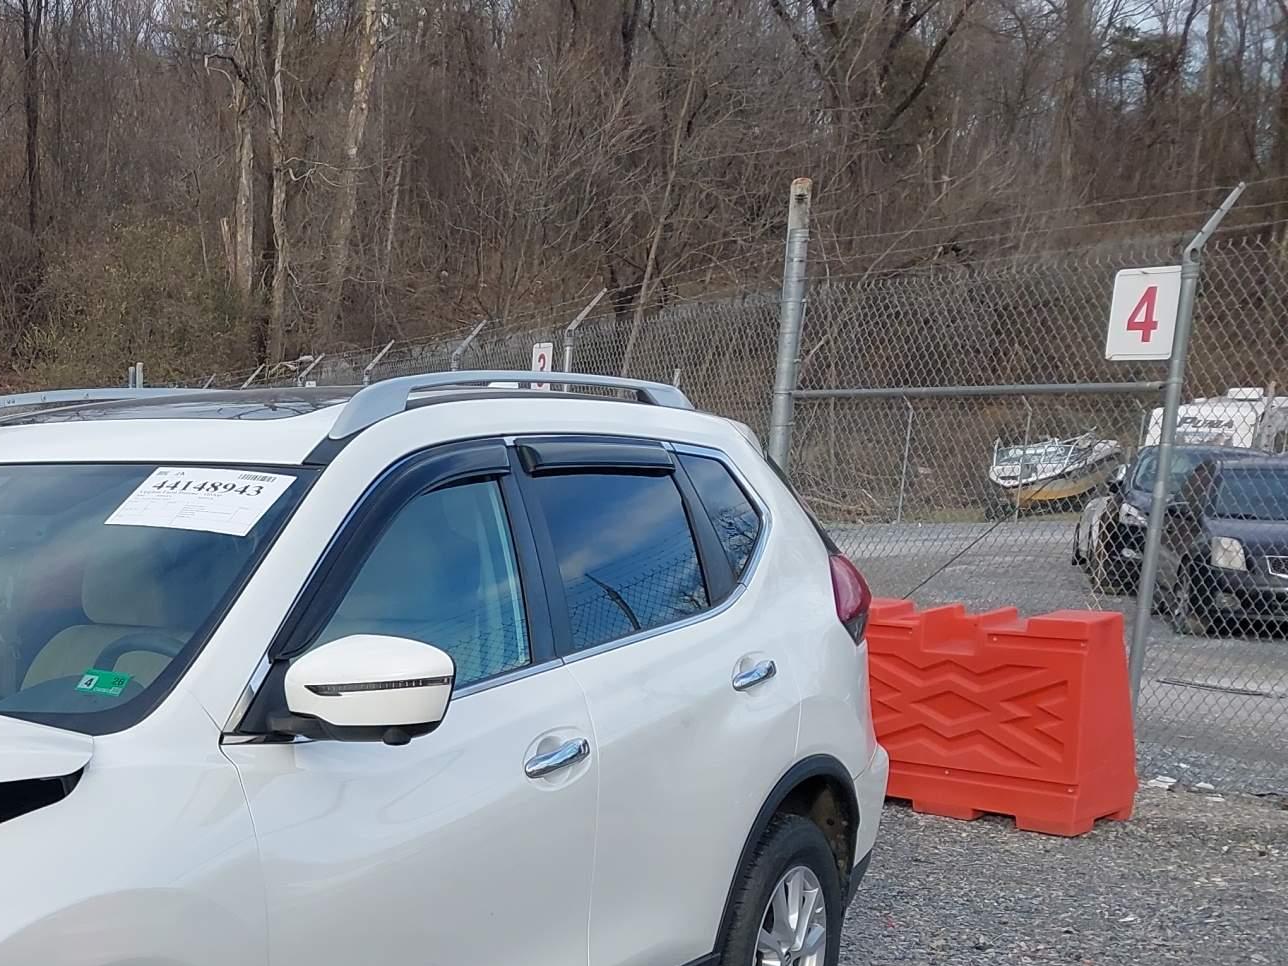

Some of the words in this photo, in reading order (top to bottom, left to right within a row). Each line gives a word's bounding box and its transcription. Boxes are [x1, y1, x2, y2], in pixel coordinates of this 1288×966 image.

[1127, 286, 1158, 342] 4
[152, 480, 265, 497] 44148943
[84, 678, 94, 687] 4
